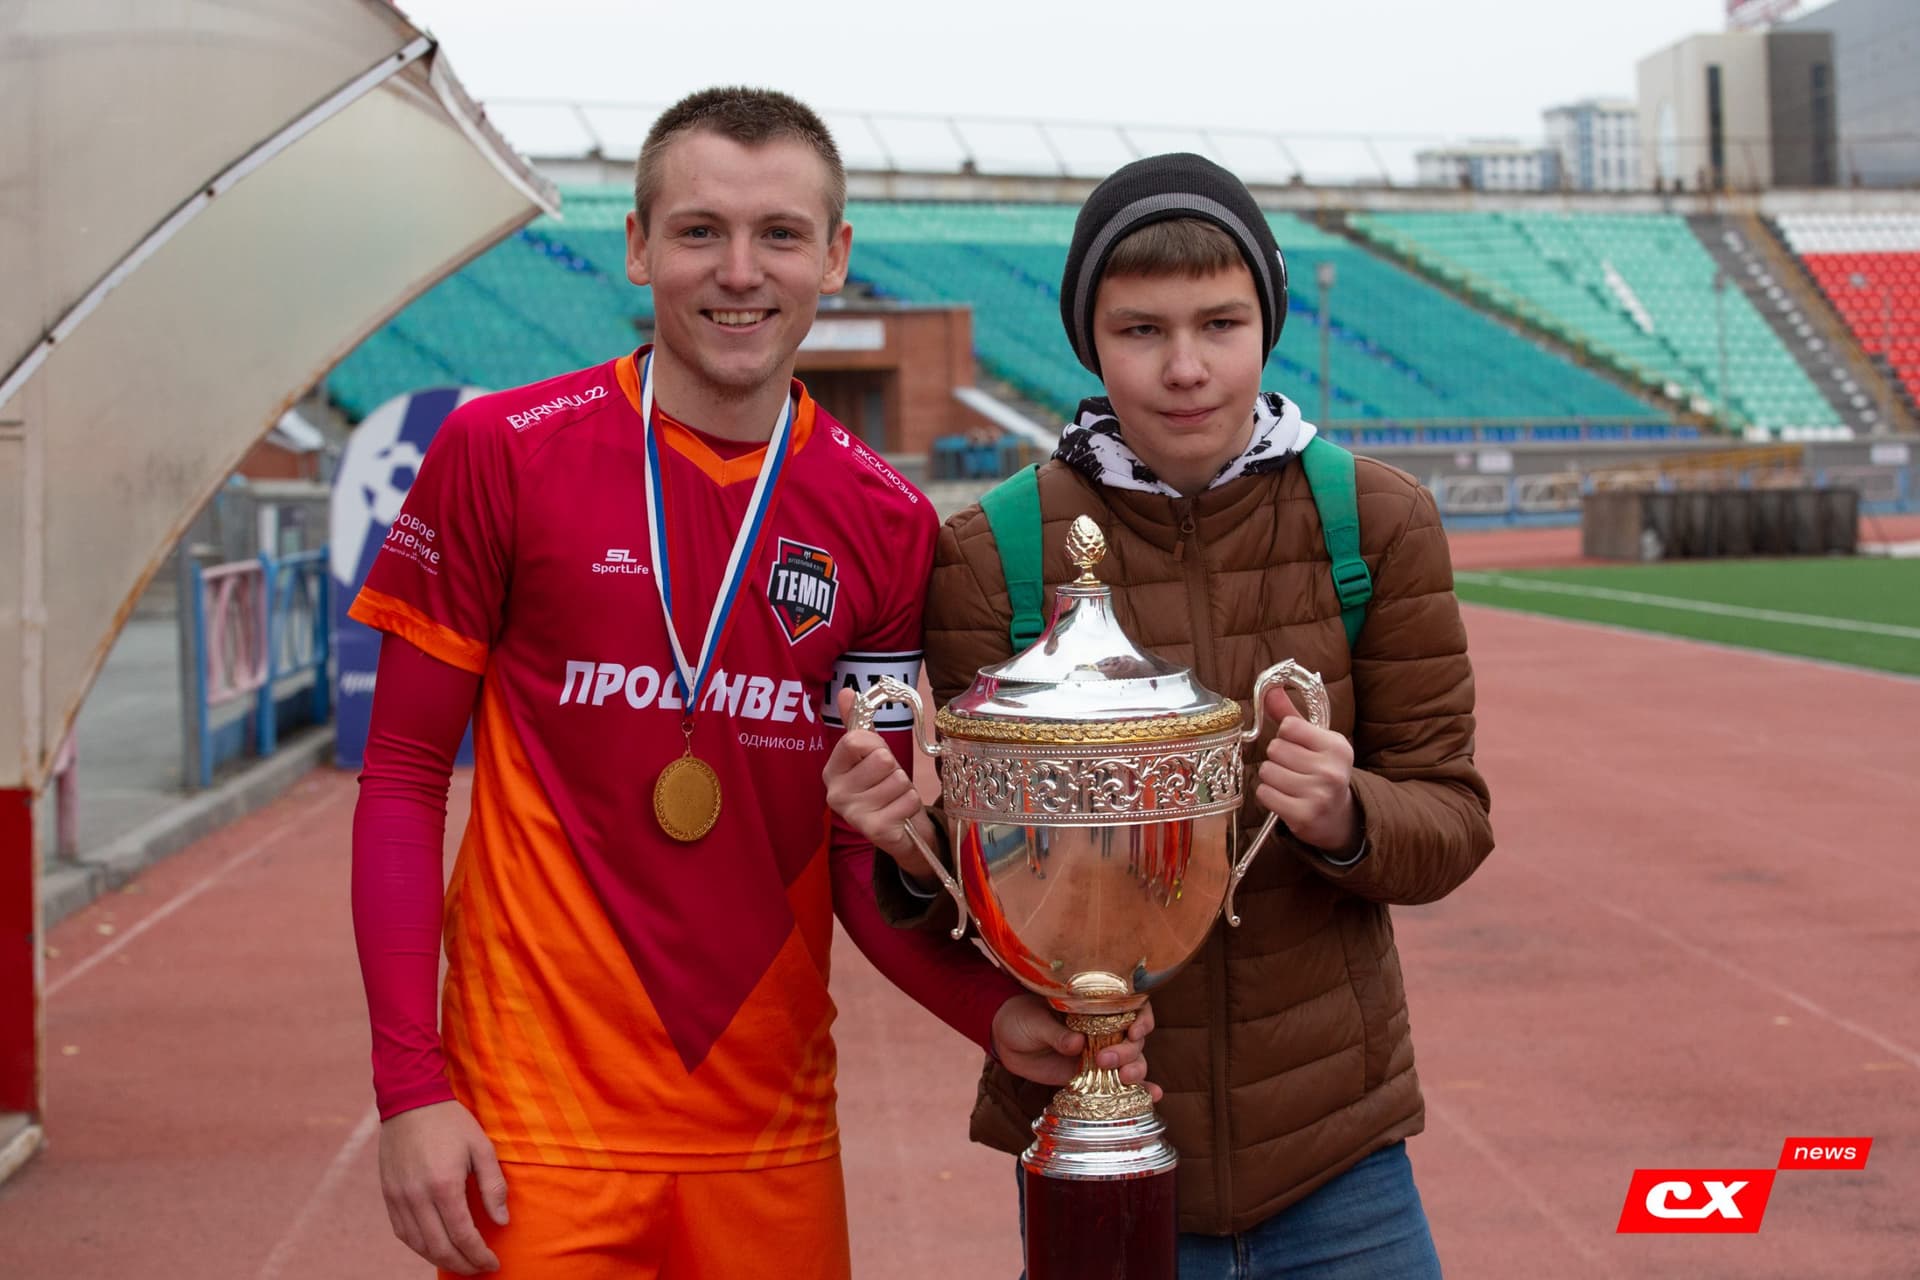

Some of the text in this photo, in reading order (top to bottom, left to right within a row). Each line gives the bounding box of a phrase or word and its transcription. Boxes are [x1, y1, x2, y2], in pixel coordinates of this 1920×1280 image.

[506, 386, 609, 430] BARNAUL22
[854, 444, 919, 504] ЭКСКЛЮЗИВ
[592, 563, 649, 574] SportLife
[776, 569, 831, 614] ТЕМП
[738, 732, 805, 751] ОДНИКОВ
